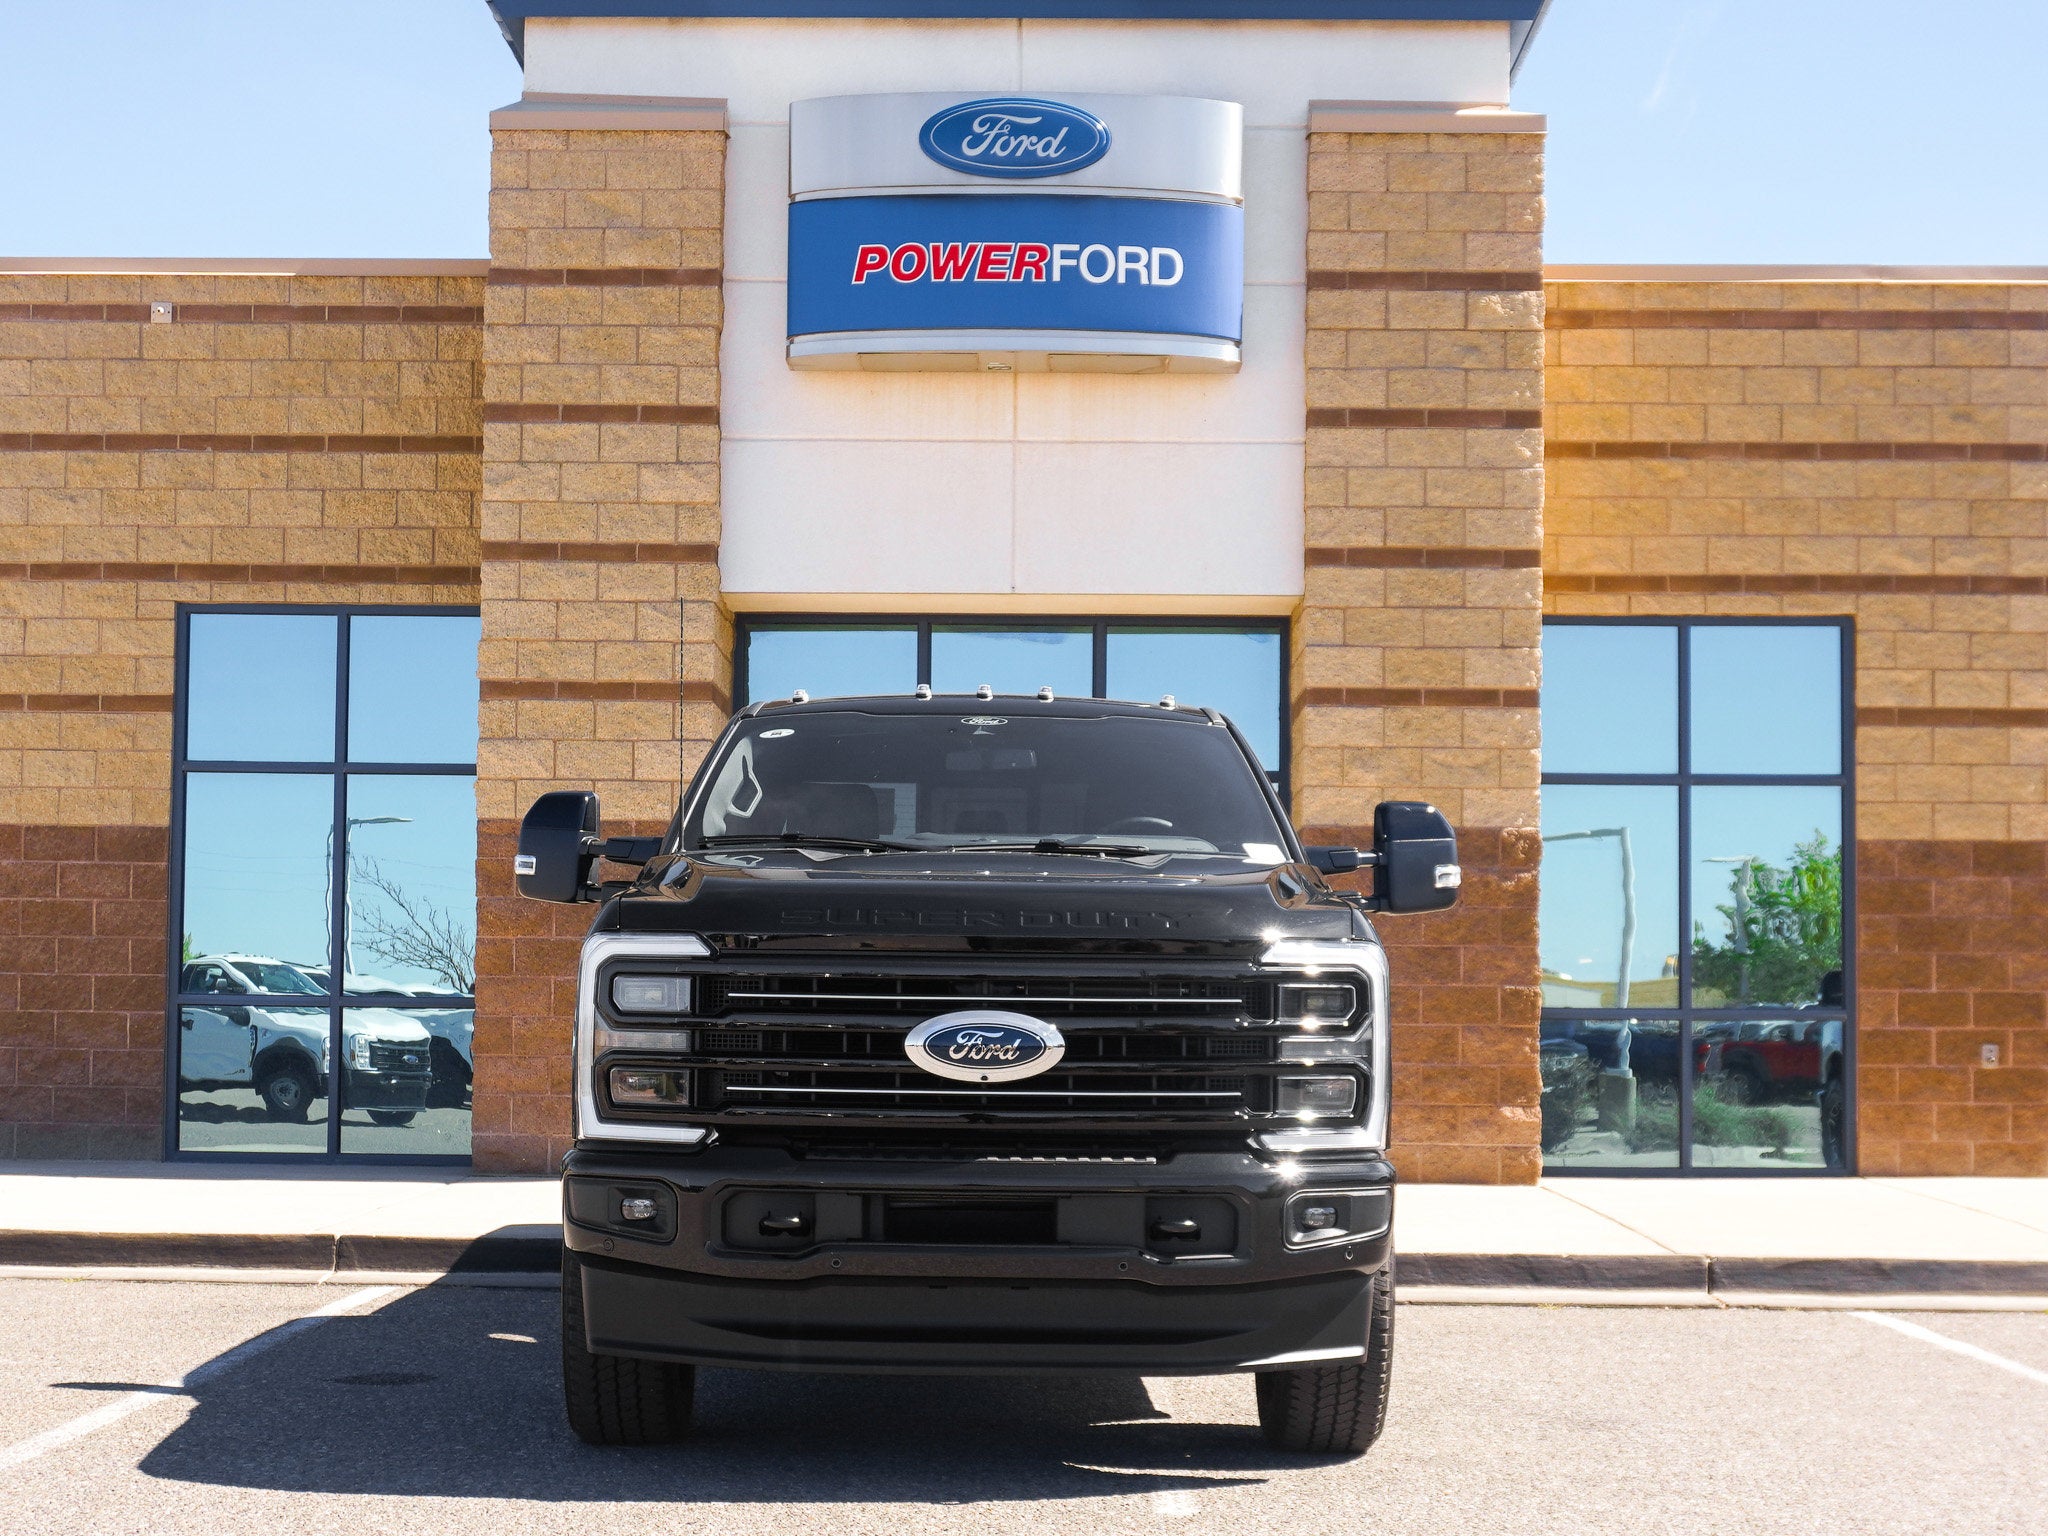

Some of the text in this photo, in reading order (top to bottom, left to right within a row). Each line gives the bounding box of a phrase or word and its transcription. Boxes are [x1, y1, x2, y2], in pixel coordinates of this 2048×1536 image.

[961, 113, 1069, 158] Ford
[851, 242, 1184, 286] POWERFORD
[780, 908, 1194, 929] SUPER DUTY
[948, 1030, 1022, 1060] Ford
